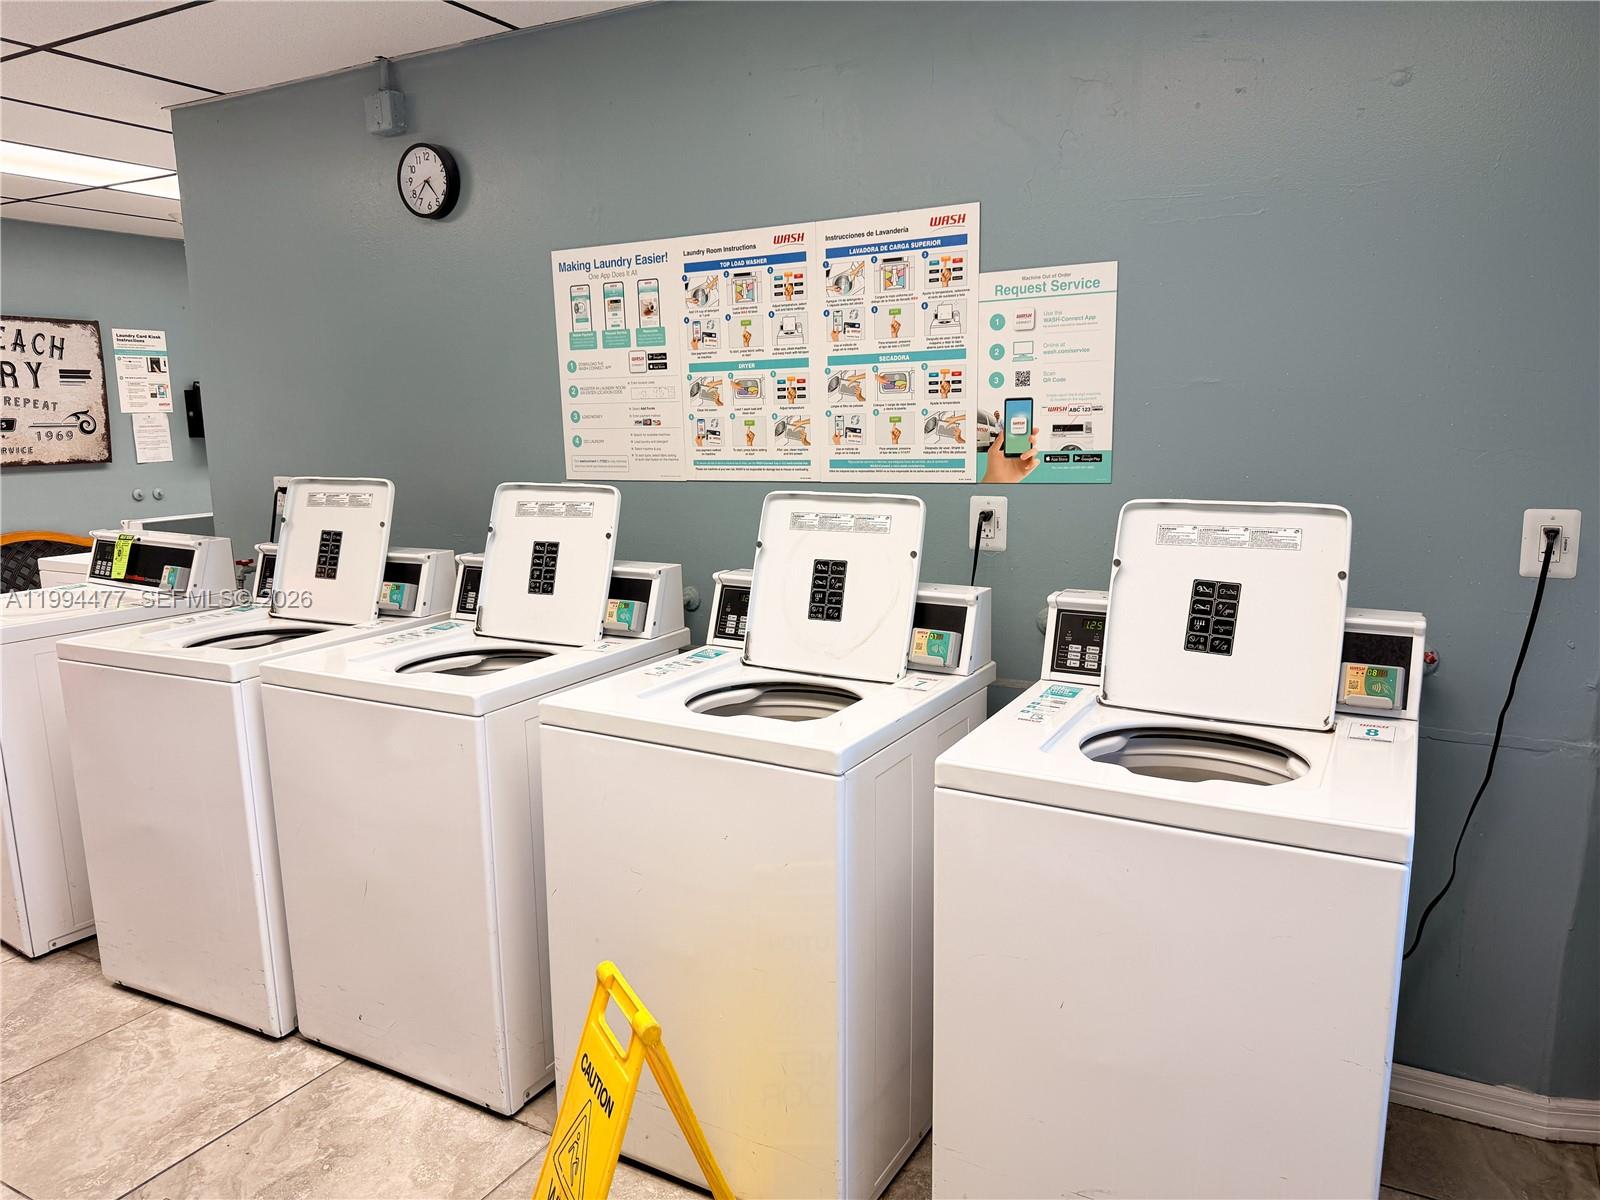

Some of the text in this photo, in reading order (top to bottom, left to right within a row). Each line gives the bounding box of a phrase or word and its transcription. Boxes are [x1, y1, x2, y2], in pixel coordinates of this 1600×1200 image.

[423, 152, 429, 161] 12
[408, 177, 413, 186] 9
[412, 189, 417, 199] 8
[930, 213, 966, 227] WASH
[773, 233, 805, 244] WASH
[825, 232, 865, 241] Instrucciones
[683, 243, 757, 257] Laundry Room Instructions
[849, 246, 879, 255] LAVADORA
[889, 243, 910, 251] CARGA
[911, 239, 942, 249] SUPERIOR
[558, 251, 669, 273] Making Laundry Easier!
[720, 261, 730, 269] TOP
[746, 258, 768, 266] WASHER
[994, 277, 1101, 298] Request Service
[994, 347, 1000, 356] 2
[993, 376, 999, 385] 3
[571, 386, 577, 395] 2
[3, 396, 58, 412] REPEAT
[573, 412, 578, 421] 3
[36, 431, 74, 442] 1969
[1365, 728, 1379, 737] 8
[580, 1053, 615, 1120] CAUTION
